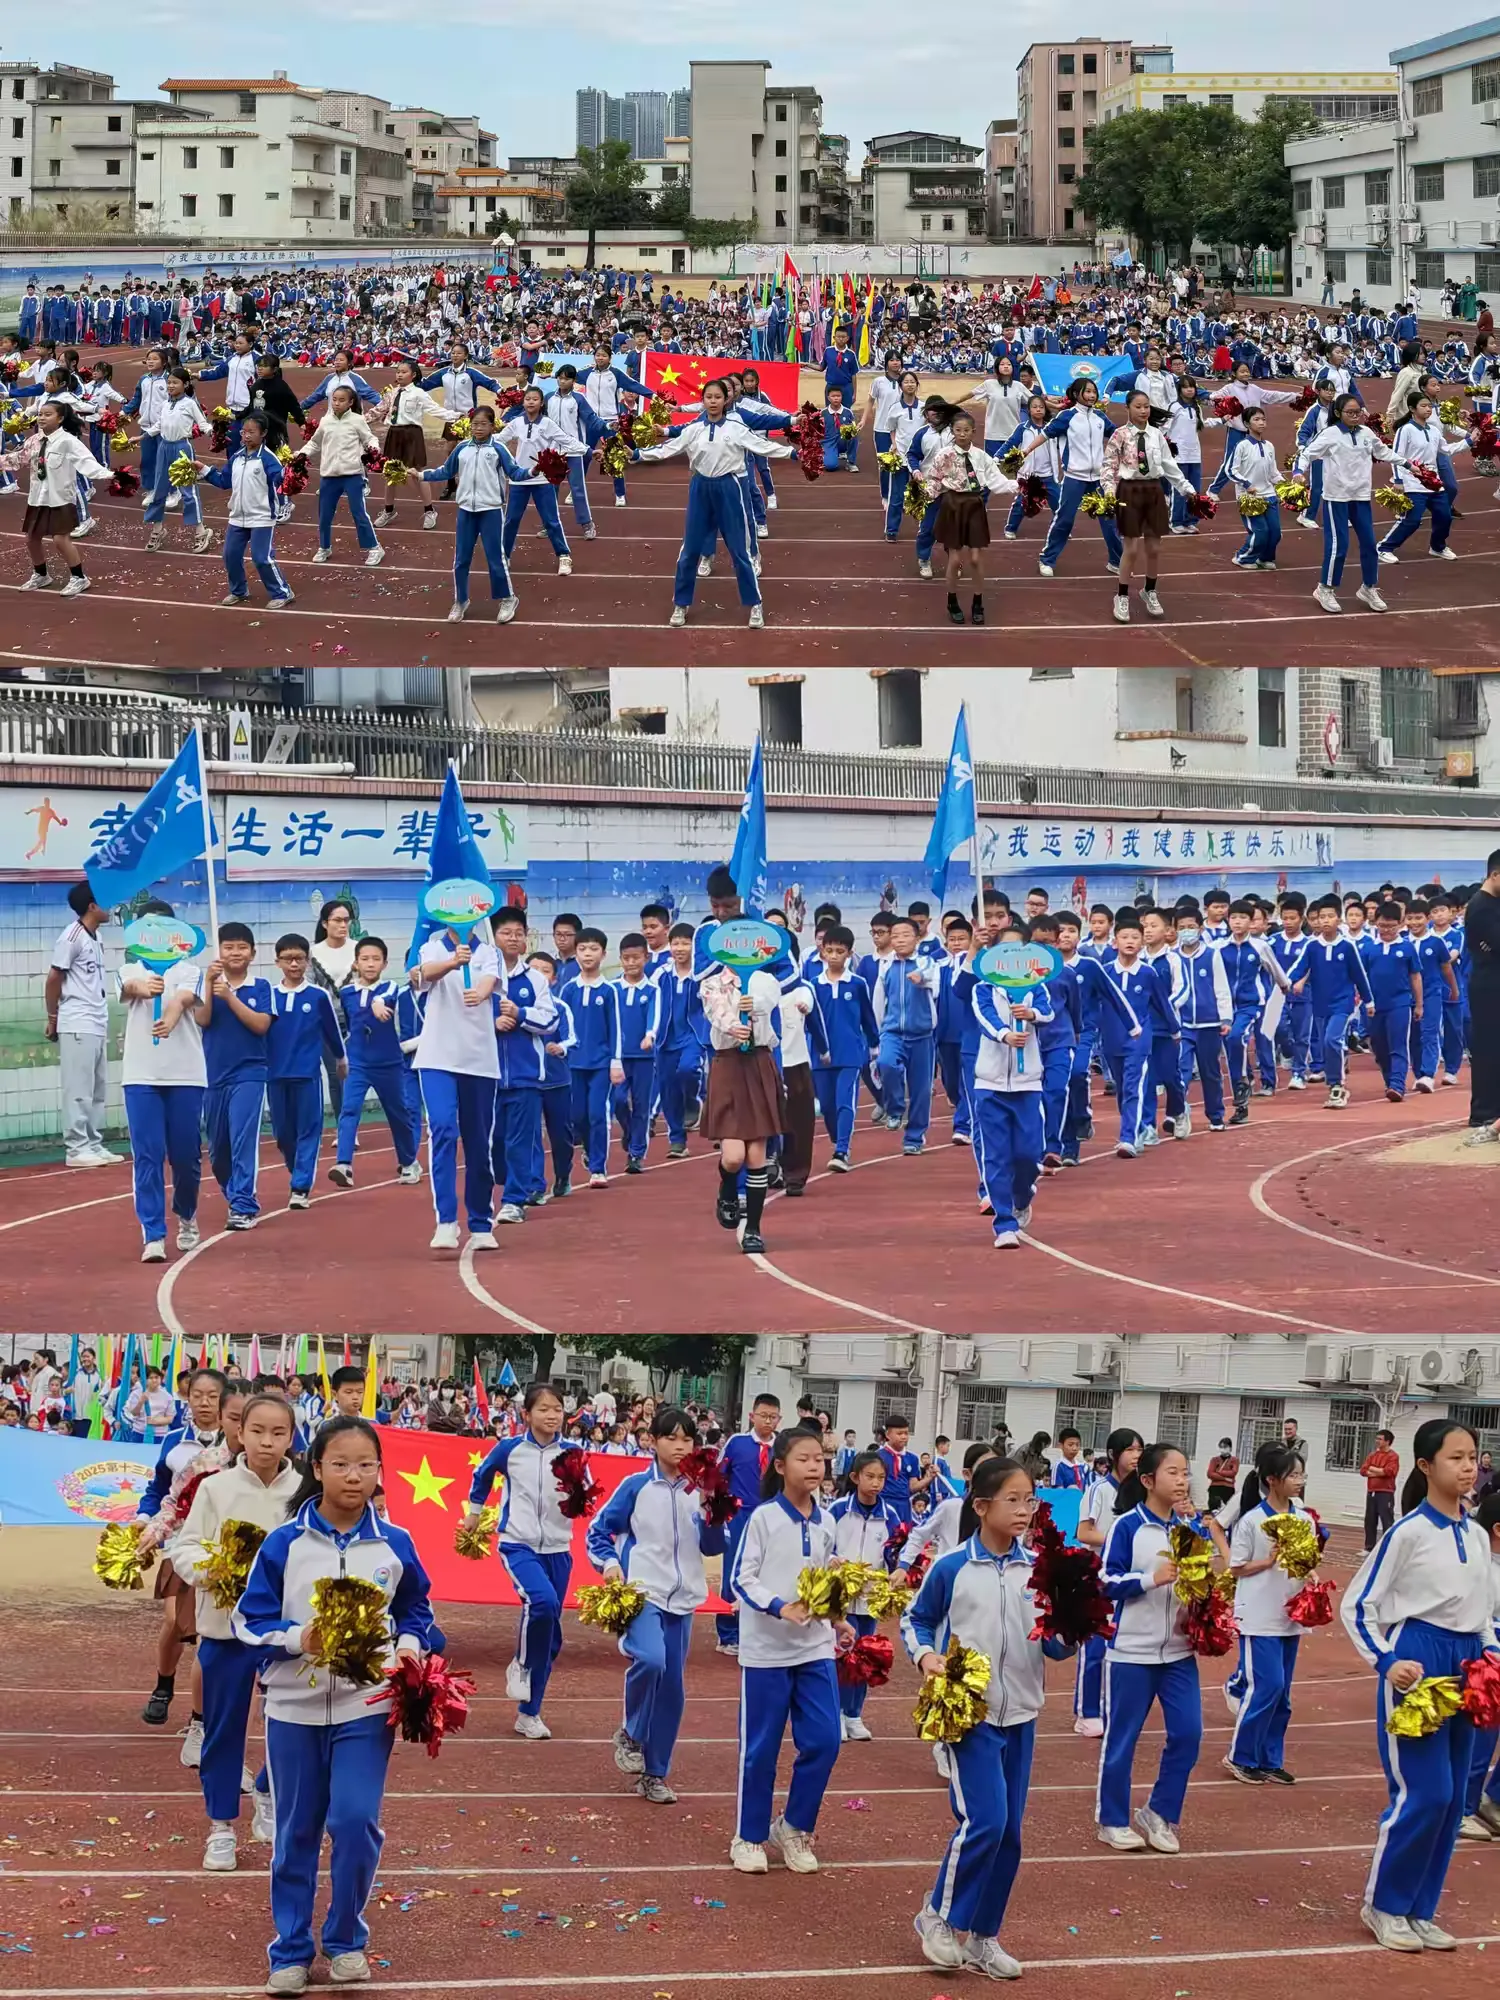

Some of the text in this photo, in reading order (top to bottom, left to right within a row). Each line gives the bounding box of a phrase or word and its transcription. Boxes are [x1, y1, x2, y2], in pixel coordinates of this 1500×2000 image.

[1007, 824, 1286, 858] 我运动 我健康 我快乐
